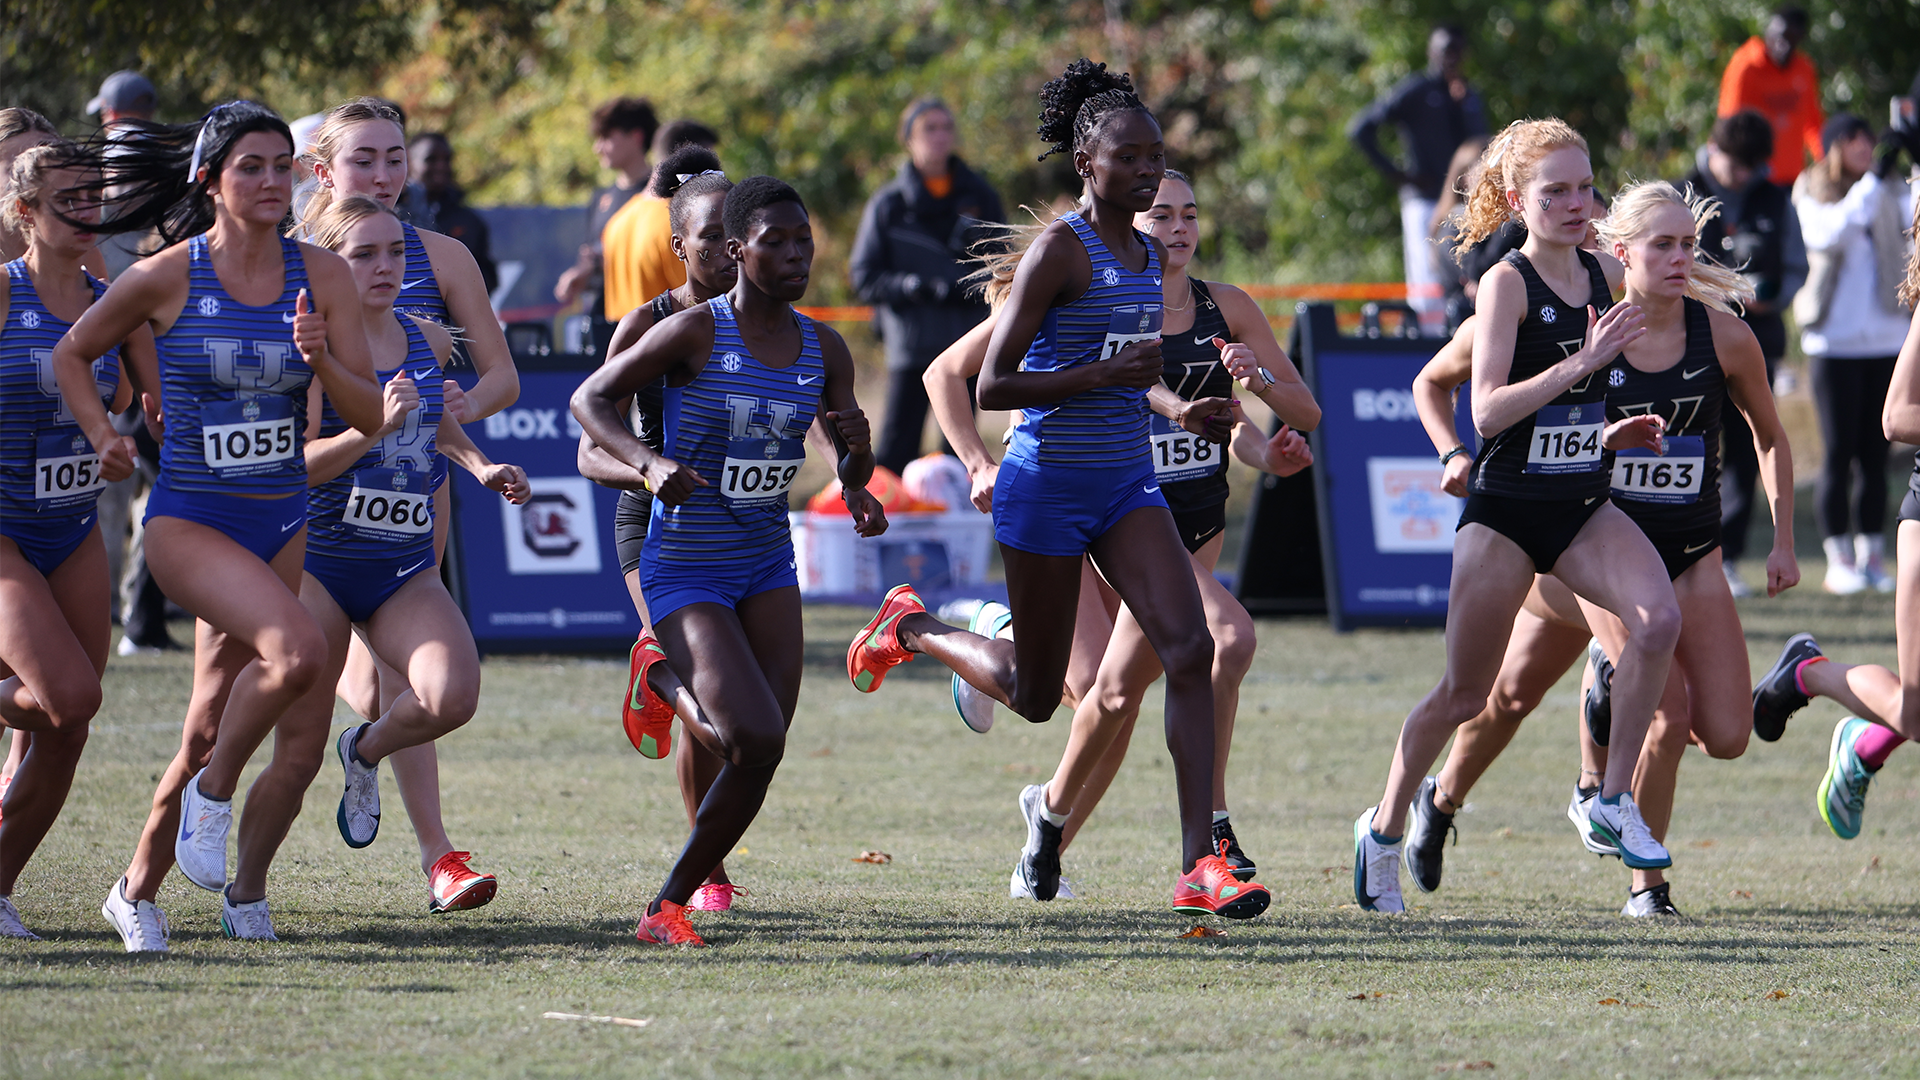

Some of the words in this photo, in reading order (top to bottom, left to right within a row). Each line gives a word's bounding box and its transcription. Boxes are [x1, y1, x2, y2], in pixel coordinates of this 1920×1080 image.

[1103, 268, 1119, 286] SEC
[22, 311, 40, 328] SEC
[199, 298, 219, 316] SEC
[1540, 306, 1557, 323] SEC
[722, 353, 742, 372] SEC
[1608, 369, 1626, 386] SEC
[484, 408, 561, 440] BOX
[208, 424, 292, 461] 1055
[1150, 436, 1212, 467] 158
[1539, 429, 1598, 459] 1164
[727, 465, 798, 493] 1059
[1622, 462, 1694, 489] 1163
[353, 494, 430, 528] 1060
